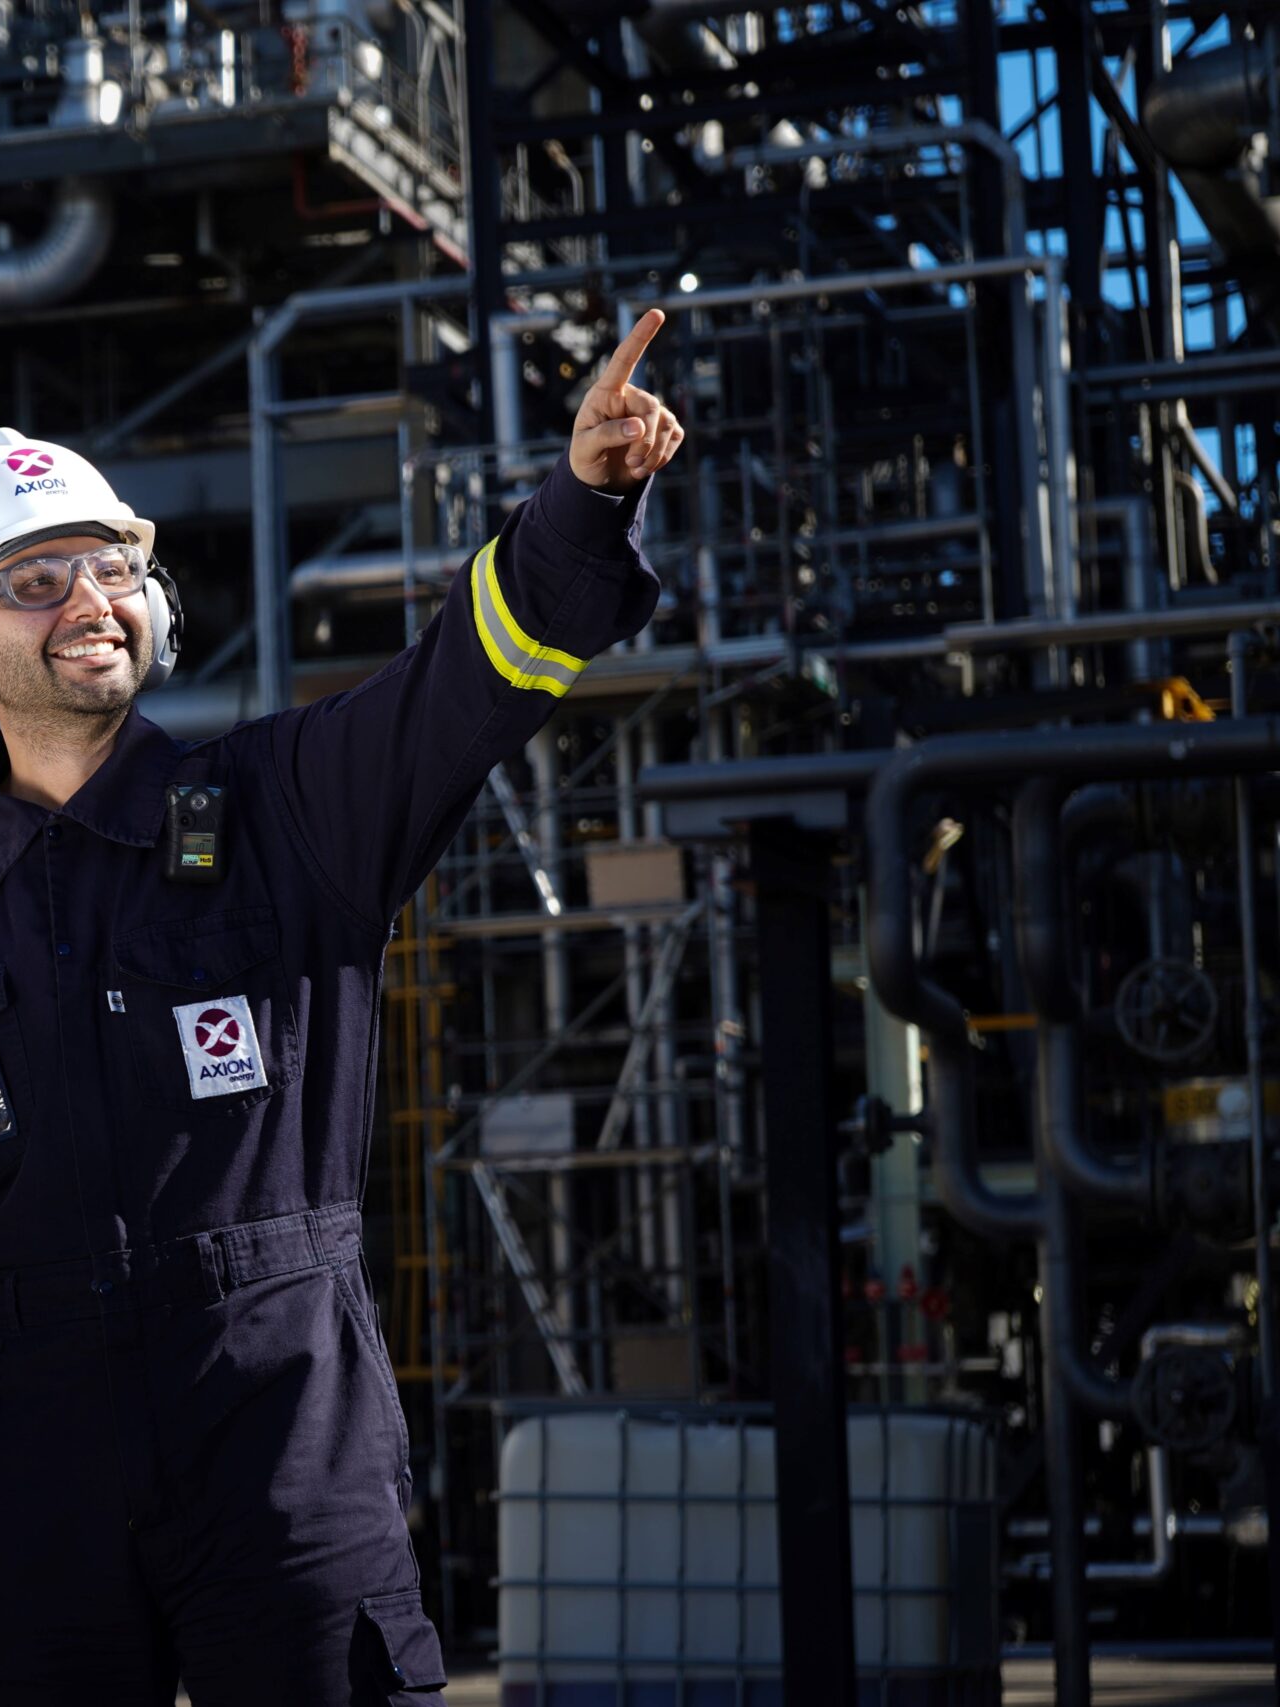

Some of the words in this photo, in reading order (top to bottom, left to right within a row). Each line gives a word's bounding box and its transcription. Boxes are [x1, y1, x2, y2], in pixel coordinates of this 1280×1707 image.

[15, 478, 66, 496] AXION
[200, 1057, 253, 1080] AXION
[229, 1072, 255, 1082] energy
